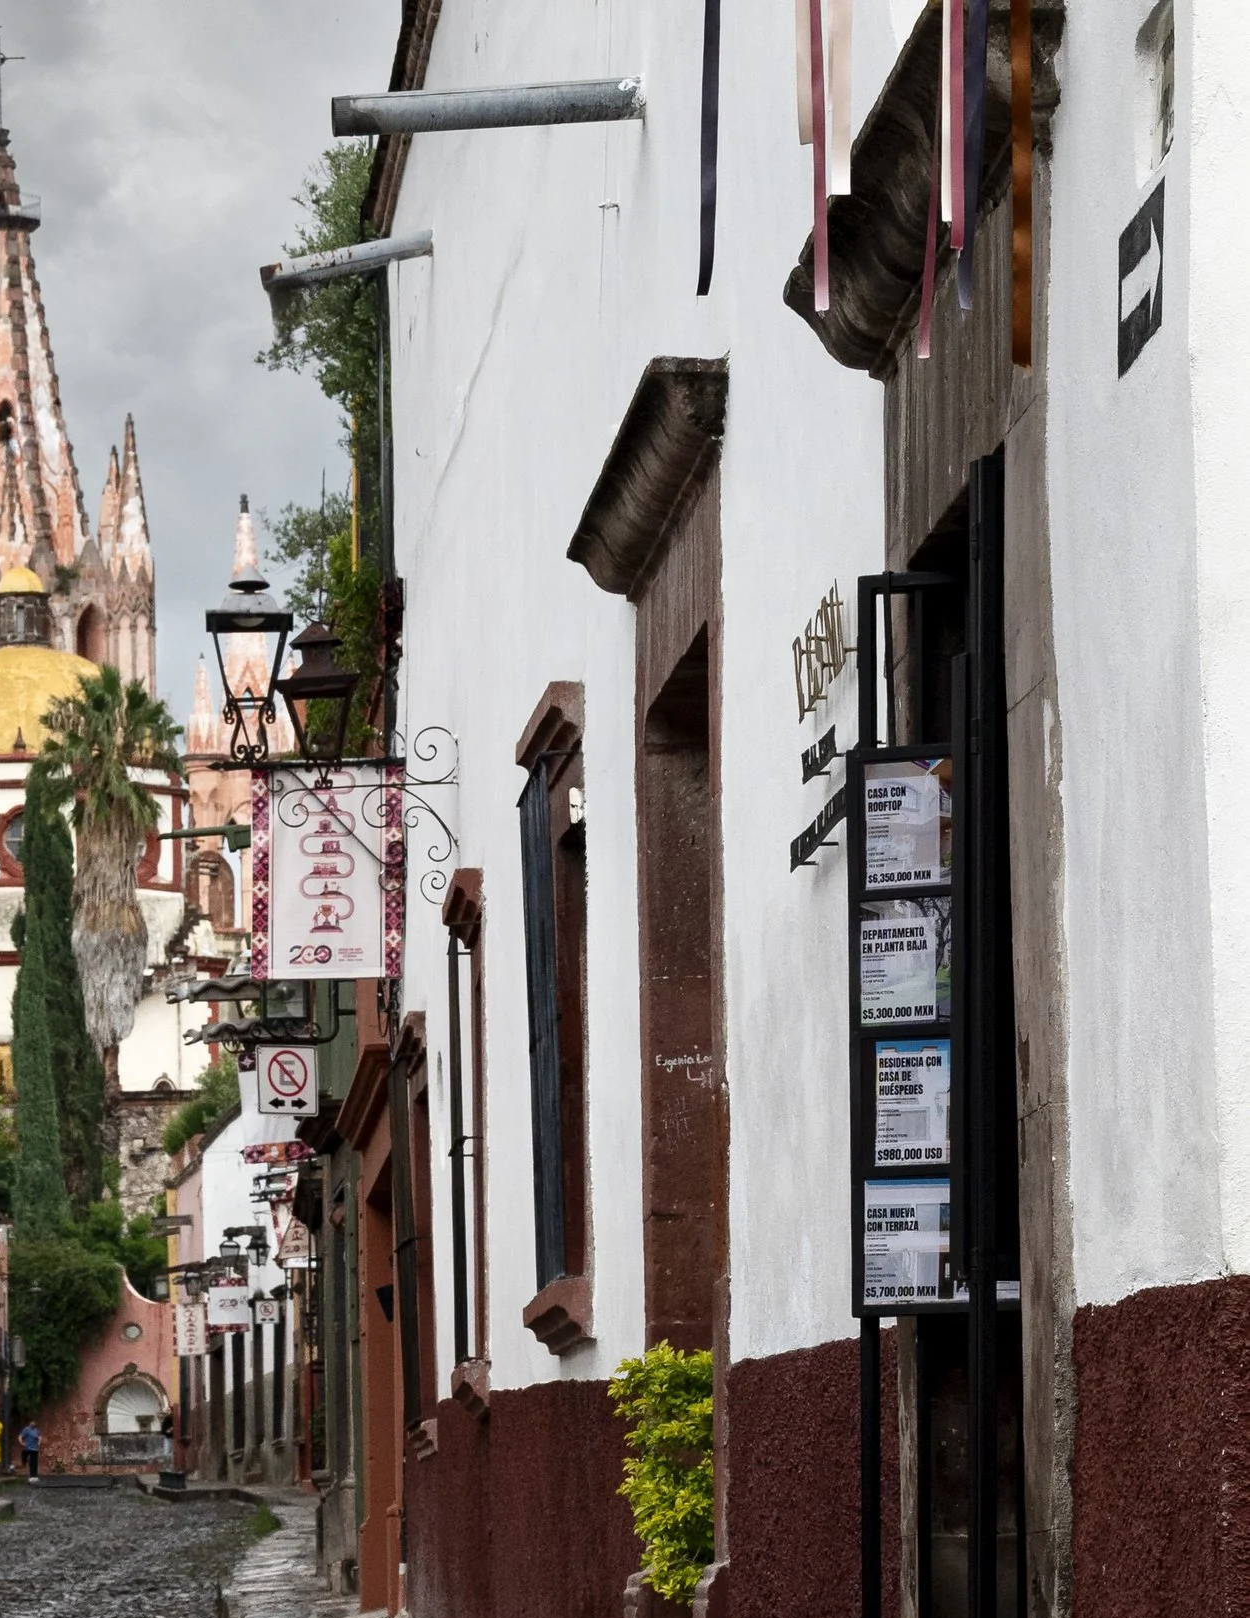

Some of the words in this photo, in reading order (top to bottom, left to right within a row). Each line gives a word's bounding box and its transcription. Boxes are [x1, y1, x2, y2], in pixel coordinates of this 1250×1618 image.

[867, 787, 888, 800] CASA
[890, 786, 906, 797] CON
[867, 800, 902, 812] ROOFTOP
[868, 871, 912, 884] $6,350,000
[913, 869, 931, 880] MXN
[862, 926, 925, 940] DEPARTAMENTO
[862, 943, 872, 954] EN
[875, 941, 904, 953] PLANTA
[906, 940, 927, 951] BAJA
[862, 1006, 912, 1020] $5,300,000
[914, 1004, 934, 1016] MXN
[879, 1056, 924, 1068] RESIDENCIA
[926, 1056, 942, 1067] CON
[878, 1071, 900, 1082] CASA
[901, 1070, 912, 1081] DE
[879, 1083, 924, 1096] HUÉSPEDES
[878, 1148, 922, 1161] $980,000
[924, 1147, 943, 1159] USD
[867, 1208, 888, 1219] CASA
[890, 1207, 915, 1218] NUEVA
[867, 1222, 882, 1232] CON
[885, 1220, 919, 1232] TERRAZA
[865, 1286, 915, 1298] $5,700,000
[916, 1285, 936, 1297] MXN
